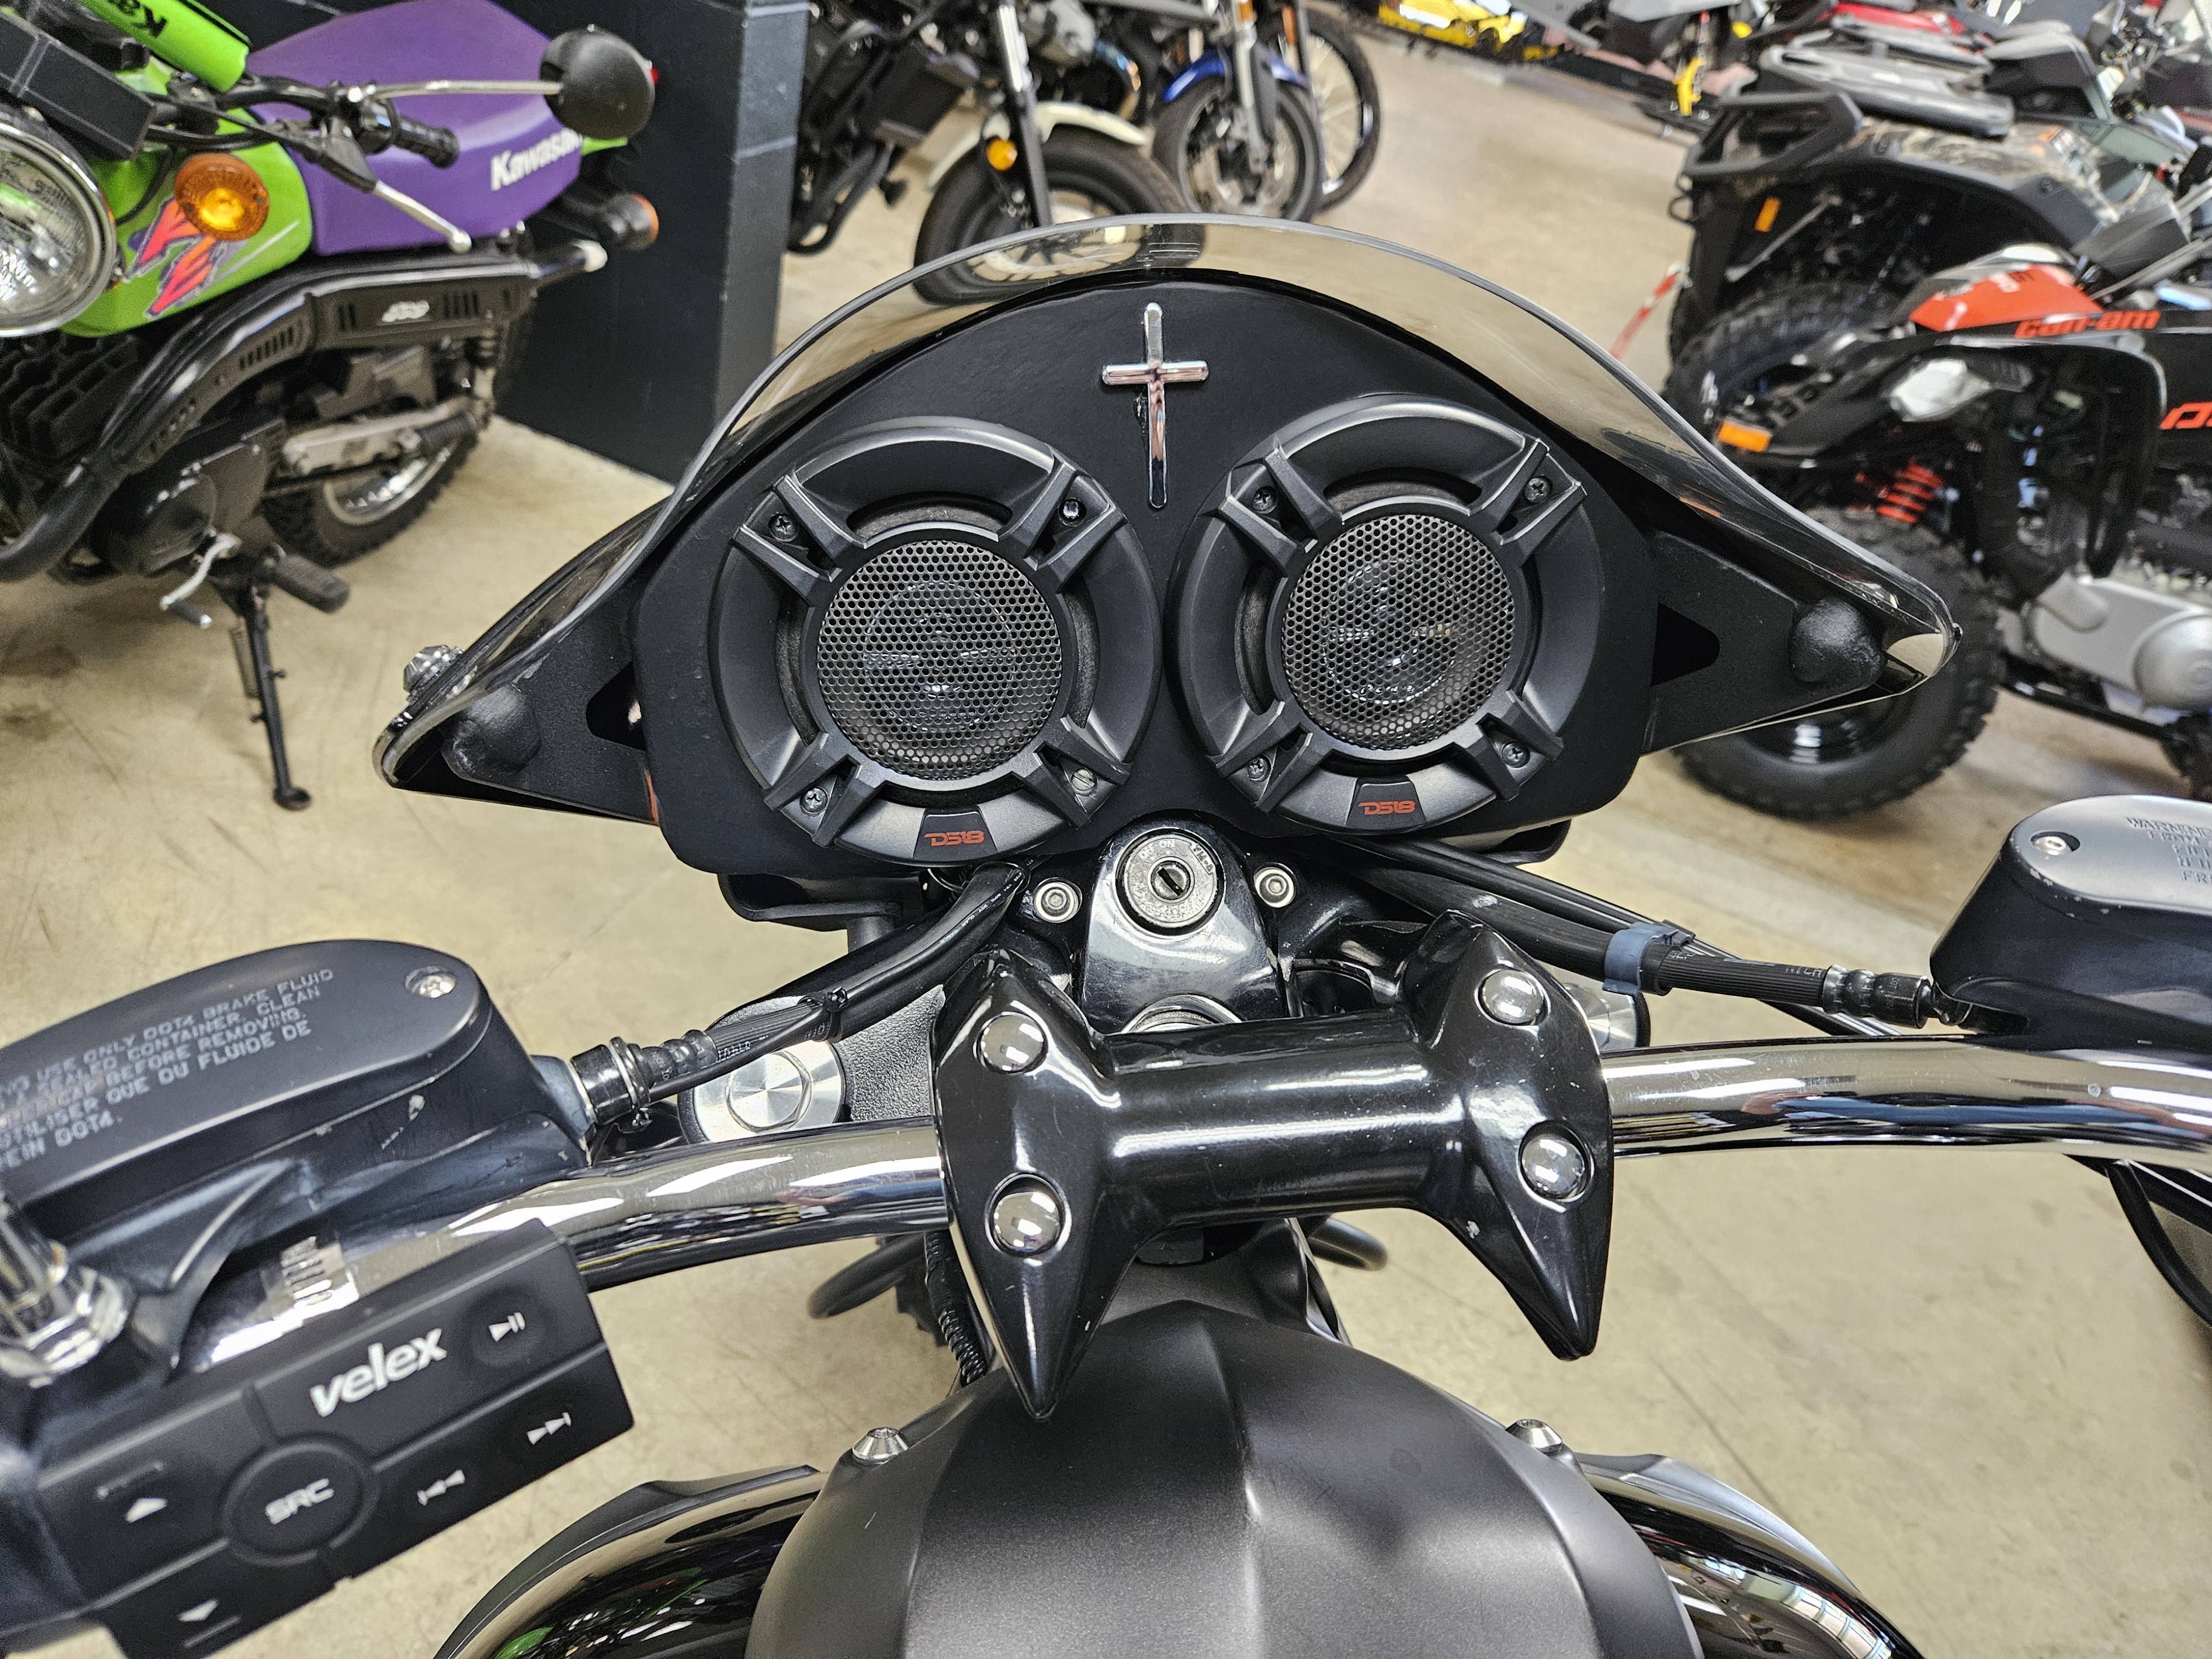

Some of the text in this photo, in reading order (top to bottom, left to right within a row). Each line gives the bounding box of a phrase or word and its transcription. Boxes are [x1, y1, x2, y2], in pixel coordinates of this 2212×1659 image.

[491, 127, 583, 191] Kawasa
[1358, 800, 1416, 815] DS18
[923, 830, 985, 847] DS18
[1159, 839, 1176, 849] ON
[84, 1032, 136, 1064] ONLY
[202, 989, 269, 1019] BRAKE
[277, 969, 333, 994] FLUID
[256, 985, 320, 1016] CLEAN
[106, 1076, 150, 1105] QUE
[158, 1061, 189, 1086] DU
[197, 1030, 275, 1071] FLUIDE
[281, 1020, 311, 1042] DE
[309, 1327, 448, 1418] velex
[264, 1477, 335, 1525] SRC
